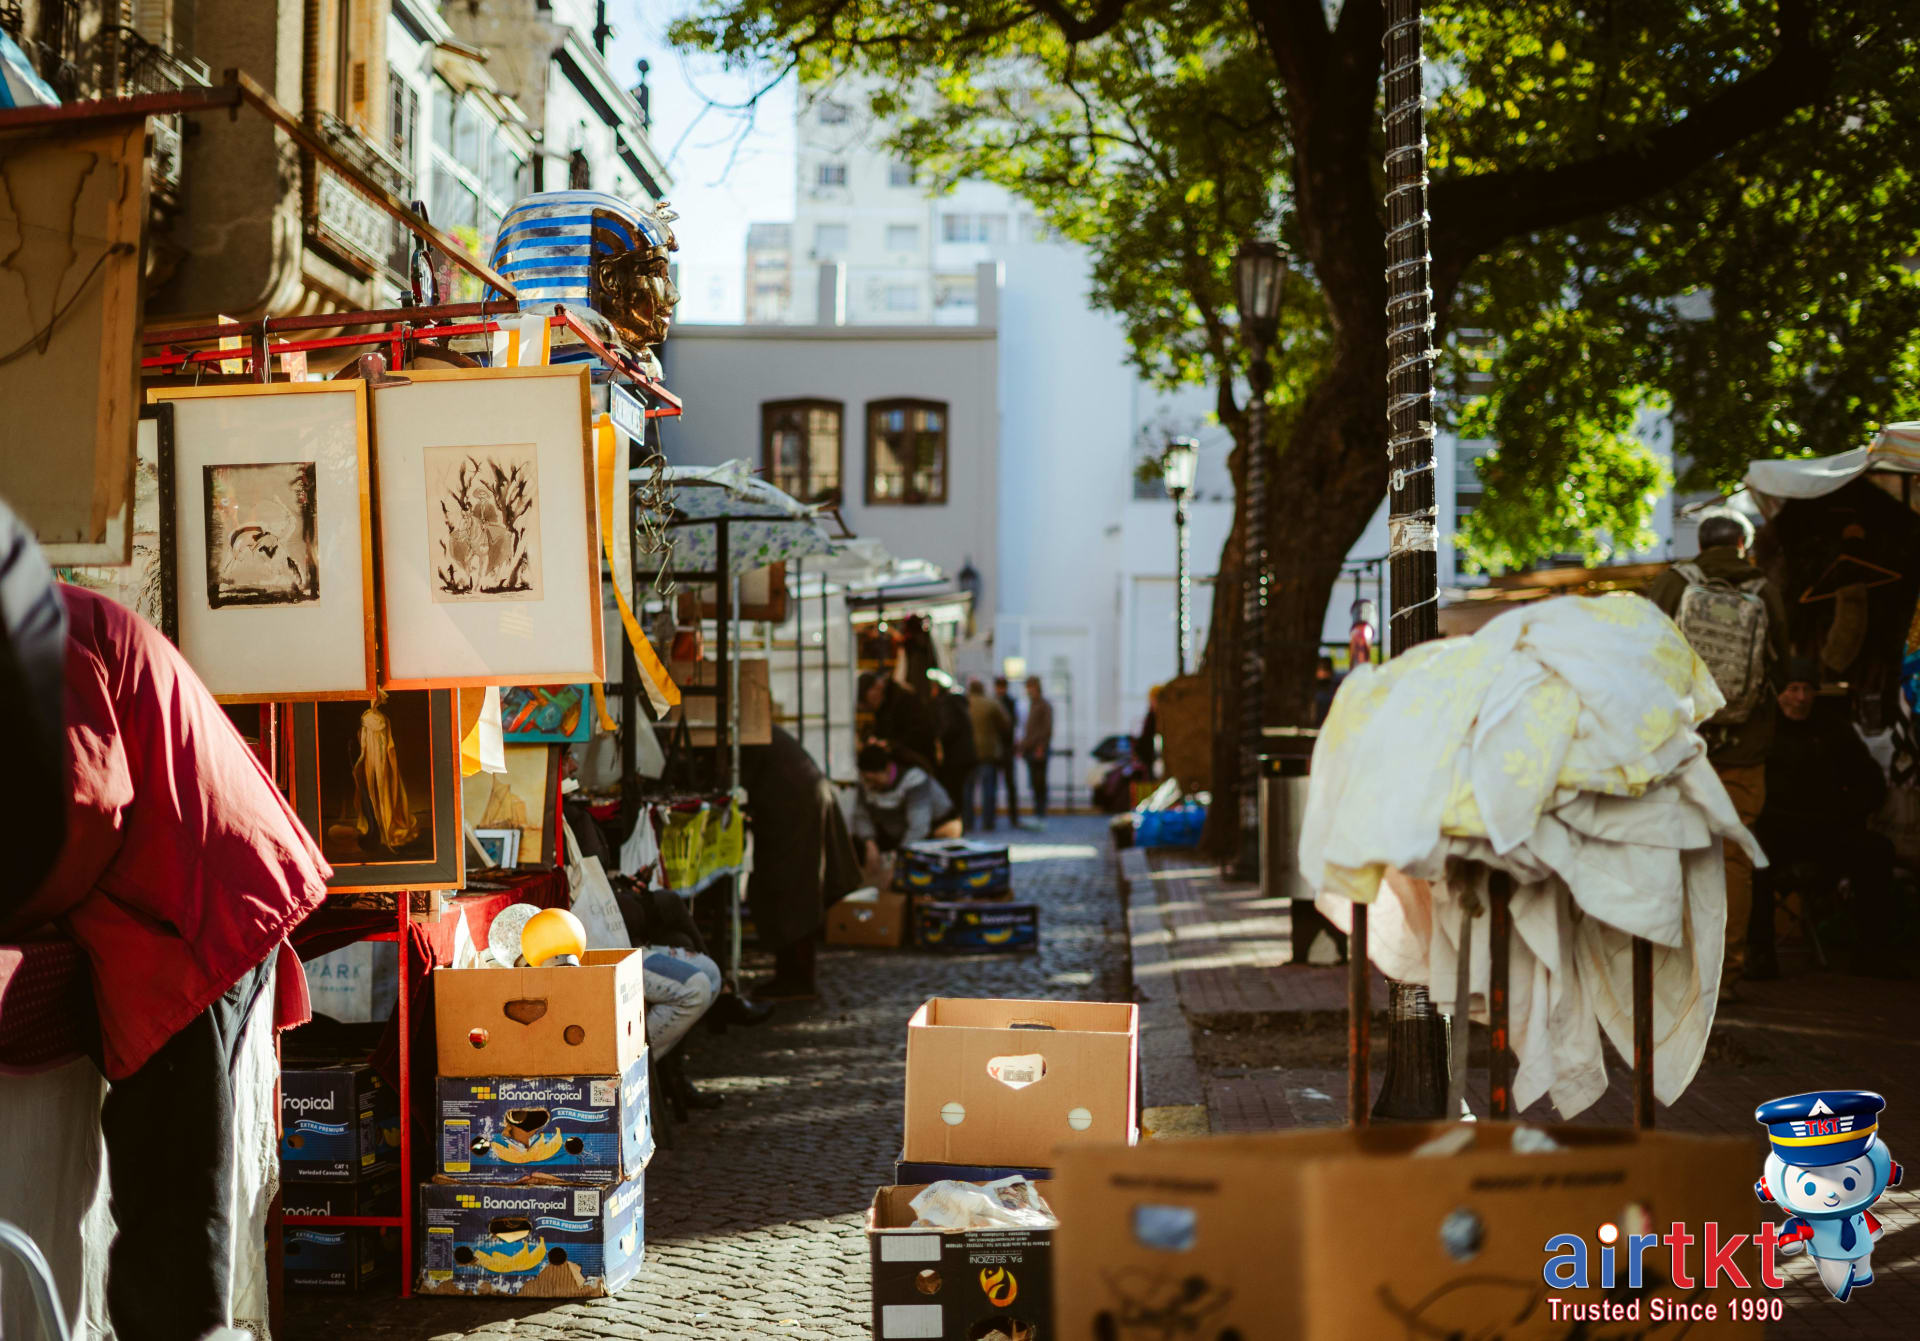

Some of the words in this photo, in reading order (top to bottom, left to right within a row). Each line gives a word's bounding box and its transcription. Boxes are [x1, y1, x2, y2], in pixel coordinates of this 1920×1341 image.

[498, 1087, 582, 1104] BananaTropical
[557, 1110, 576, 1118] EXTRA
[577, 1112, 605, 1120] PREMIUM
[300, 1122, 317, 1130] EXTRA
[318, 1125, 345, 1133] PREMIUM
[483, 1195, 567, 1214] BananaTropical
[541, 1219, 561, 1227] EXTRA
[561, 1222, 589, 1230] PREMIUM
[969, 1255, 1007, 1264] SELEZIONI
